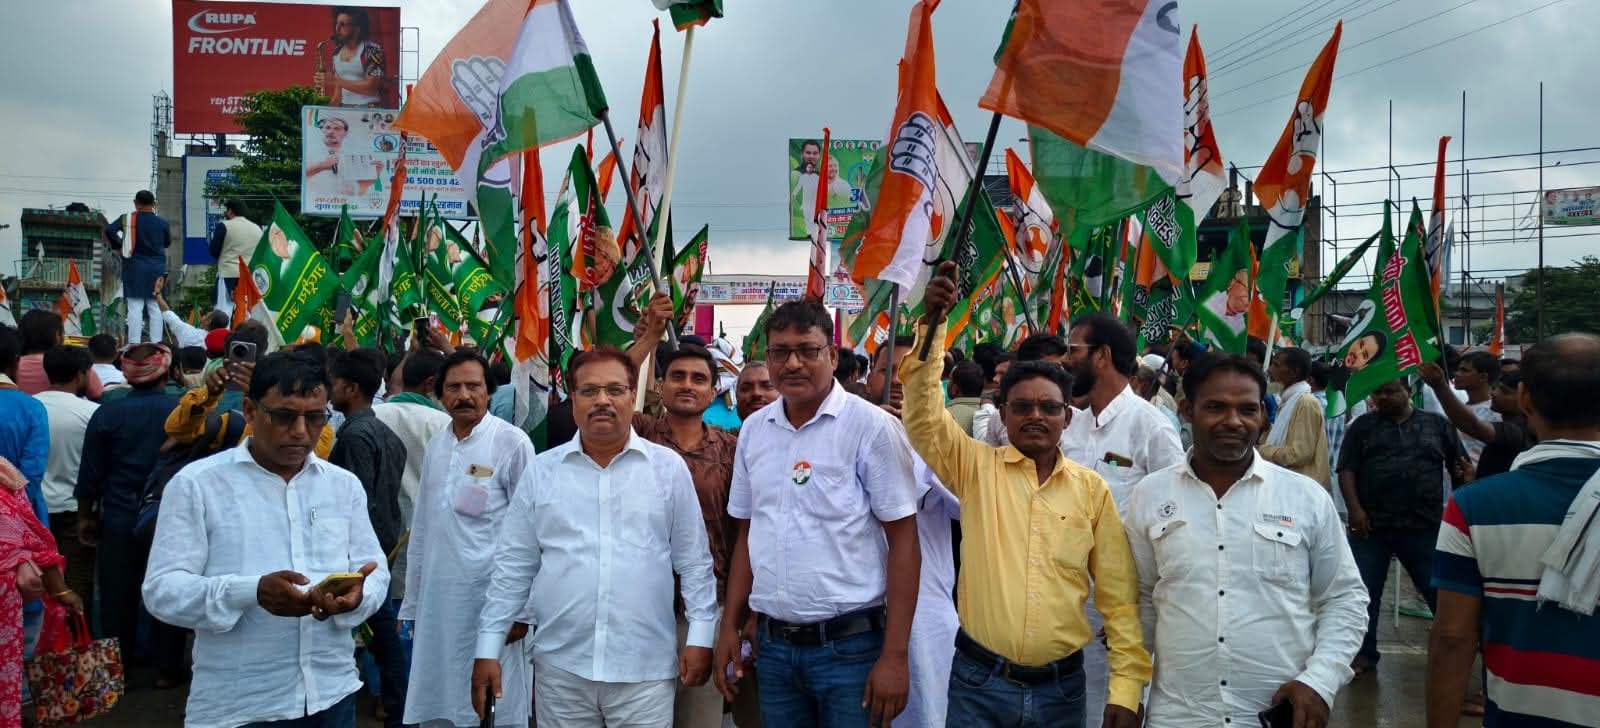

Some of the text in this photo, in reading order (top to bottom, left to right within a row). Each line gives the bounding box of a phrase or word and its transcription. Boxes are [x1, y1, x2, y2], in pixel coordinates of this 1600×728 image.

[205, 13, 256, 25] RUPA
[188, 37, 307, 56] FRONTLINE
[210, 97, 226, 105] YEH
[417, 177, 434, 185] 500
[550, 242, 561, 303] INDIAN
